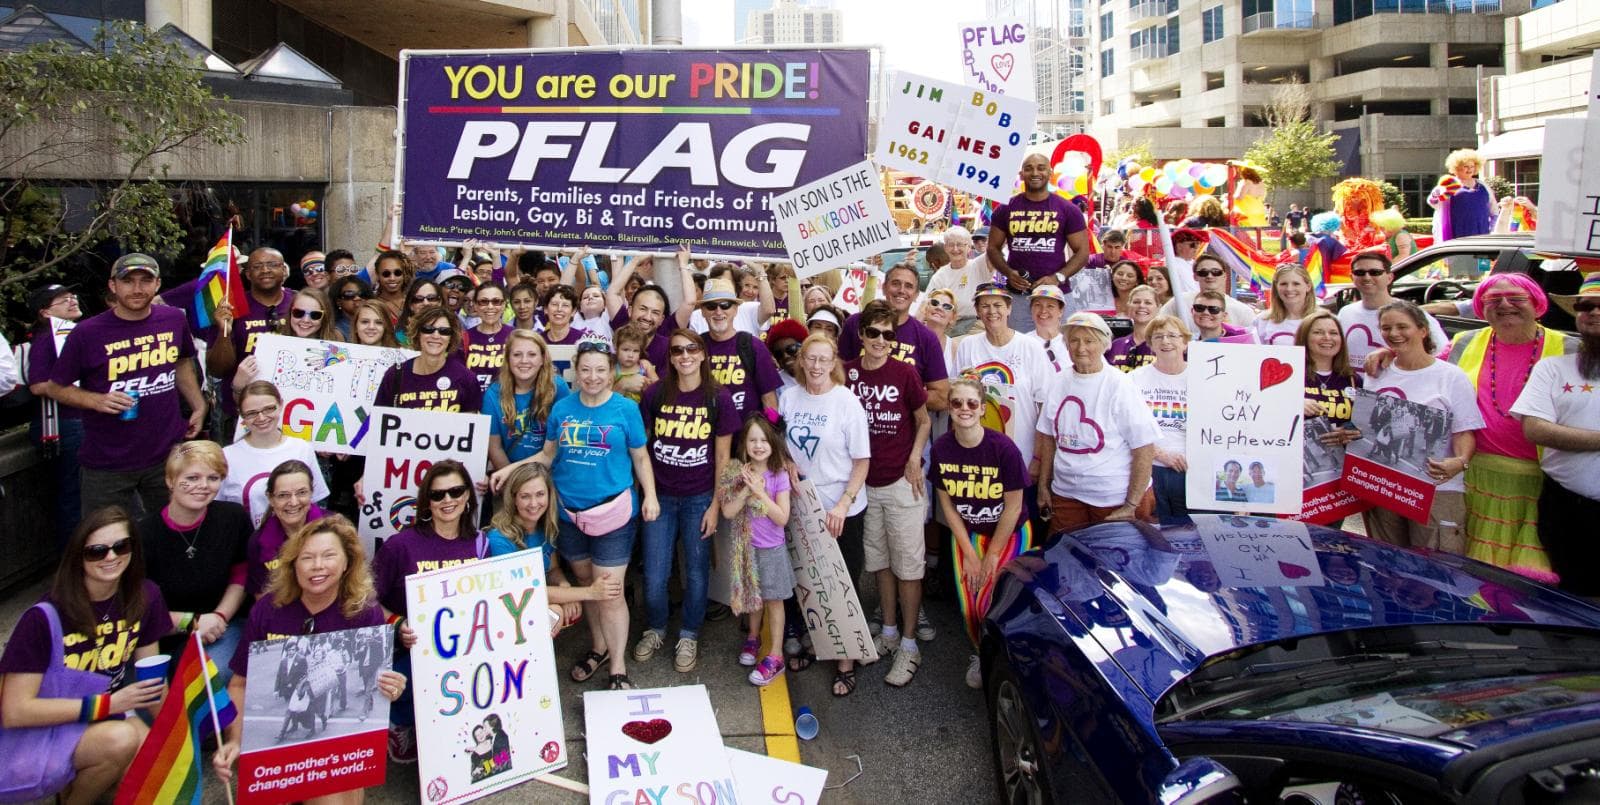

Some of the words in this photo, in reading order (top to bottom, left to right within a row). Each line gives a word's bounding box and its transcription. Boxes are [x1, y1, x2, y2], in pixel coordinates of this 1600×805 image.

[962, 24, 1025, 49] PFLAG
[444, 64, 523, 100] YOU
[536, 74, 596, 99] are
[608, 73, 676, 99] our
[689, 62, 820, 100] PRIDE!
[902, 81, 944, 103] JIM
[446, 120, 812, 189] PFLAG
[889, 141, 929, 165] 1962
[957, 162, 1001, 190] 1994
[457, 184, 523, 205] Parents,
[531, 186, 602, 205] Families
[610, 188, 646, 207] and
[654, 190, 724, 210] Friends
[733, 192, 754, 211] of
[778, 197, 799, 220] MY
[800, 186, 829, 211] SON
[829, 181, 843, 200] IS
[842, 170, 871, 194] THE
[453, 204, 520, 225] Lesbian,
[527, 206, 568, 229] Gay,
[576, 208, 593, 225] Bi
[600, 209, 614, 226] &
[622, 210, 674, 228] Trans
[682, 212, 778, 233] Communi
[798, 200, 868, 240] BACKBONE
[1009, 215, 1060, 236] pride
[1010, 211, 1025, 219] you
[419, 225, 449, 233] Atlanta.
[450, 225, 473, 235] P'tree
[474, 226, 492, 237] City.
[493, 228, 516, 237] John's
[517, 229, 542, 238] Creek.
[544, 230, 582, 240] Marietta.
[583, 232, 616, 241] Macon.
[617, 234, 662, 244] Blairsville.
[664, 235, 710, 246] Savannah.
[712, 237, 760, 249] Brunswick.
[793, 249, 810, 269] OF
[813, 239, 843, 262] OUR
[843, 219, 892, 252] FAMILY
[1011, 237, 1057, 247] PFLAG
[245, 319, 267, 331] you
[104, 339, 131, 355] you
[134, 335, 154, 346] are
[157, 331, 173, 342] my
[900, 343, 916, 354] my
[108, 341, 179, 381] pride
[711, 354, 727, 363] are
[1206, 355, 1226, 380] I
[419, 390, 438, 400] are
[440, 389, 458, 401] my
[865, 401, 873, 410] is
[874, 402, 881, 410] a
[1235, 389, 1252, 403] My
[281, 397, 371, 450] GAY
[675, 405, 693, 416] are
[876, 410, 902, 421] value
[1221, 405, 1261, 422] GAY
[380, 413, 475, 452] Proud
[559, 424, 614, 450] ALLY
[655, 411, 712, 440] pride
[1201, 414, 1300, 450] Nephews!
[653, 439, 708, 459] PFLAG
[384, 457, 433, 490] MO
[939, 463, 960, 475] you
[962, 464, 980, 474] are
[982, 466, 999, 479] my
[1351, 466, 1368, 478] One
[1368, 473, 1402, 491] mother's
[1403, 487, 1425, 500] voice
[942, 474, 1004, 500] pride
[1346, 474, 1380, 492] changed
[1380, 487, 1393, 498] the
[1394, 493, 1424, 511] world...
[363, 491, 383, 516] of
[1319, 503, 1333, 512] the
[369, 516, 384, 530] a
[264, 559, 280, 570] yo
[416, 560, 439, 575] you
[441, 558, 463, 569] are
[416, 584, 428, 604] I
[440, 570, 503, 600] LOVE
[807, 565, 849, 658] STRAIGHT
[832, 560, 859, 618] ZAG
[853, 630, 870, 659] FOR
[96, 621, 114, 637] re
[432, 587, 535, 660] GAY
[439, 659, 529, 717] SON
[626, 693, 665, 716] I
[254, 766, 282, 778] One
[284, 753, 340, 773] mother's
[342, 748, 375, 762] voice
[607, 751, 661, 779] MY
[248, 773, 304, 793] changed
[306, 770, 328, 782] the
[330, 761, 377, 778] world...
[676, 778, 739, 805] SON
